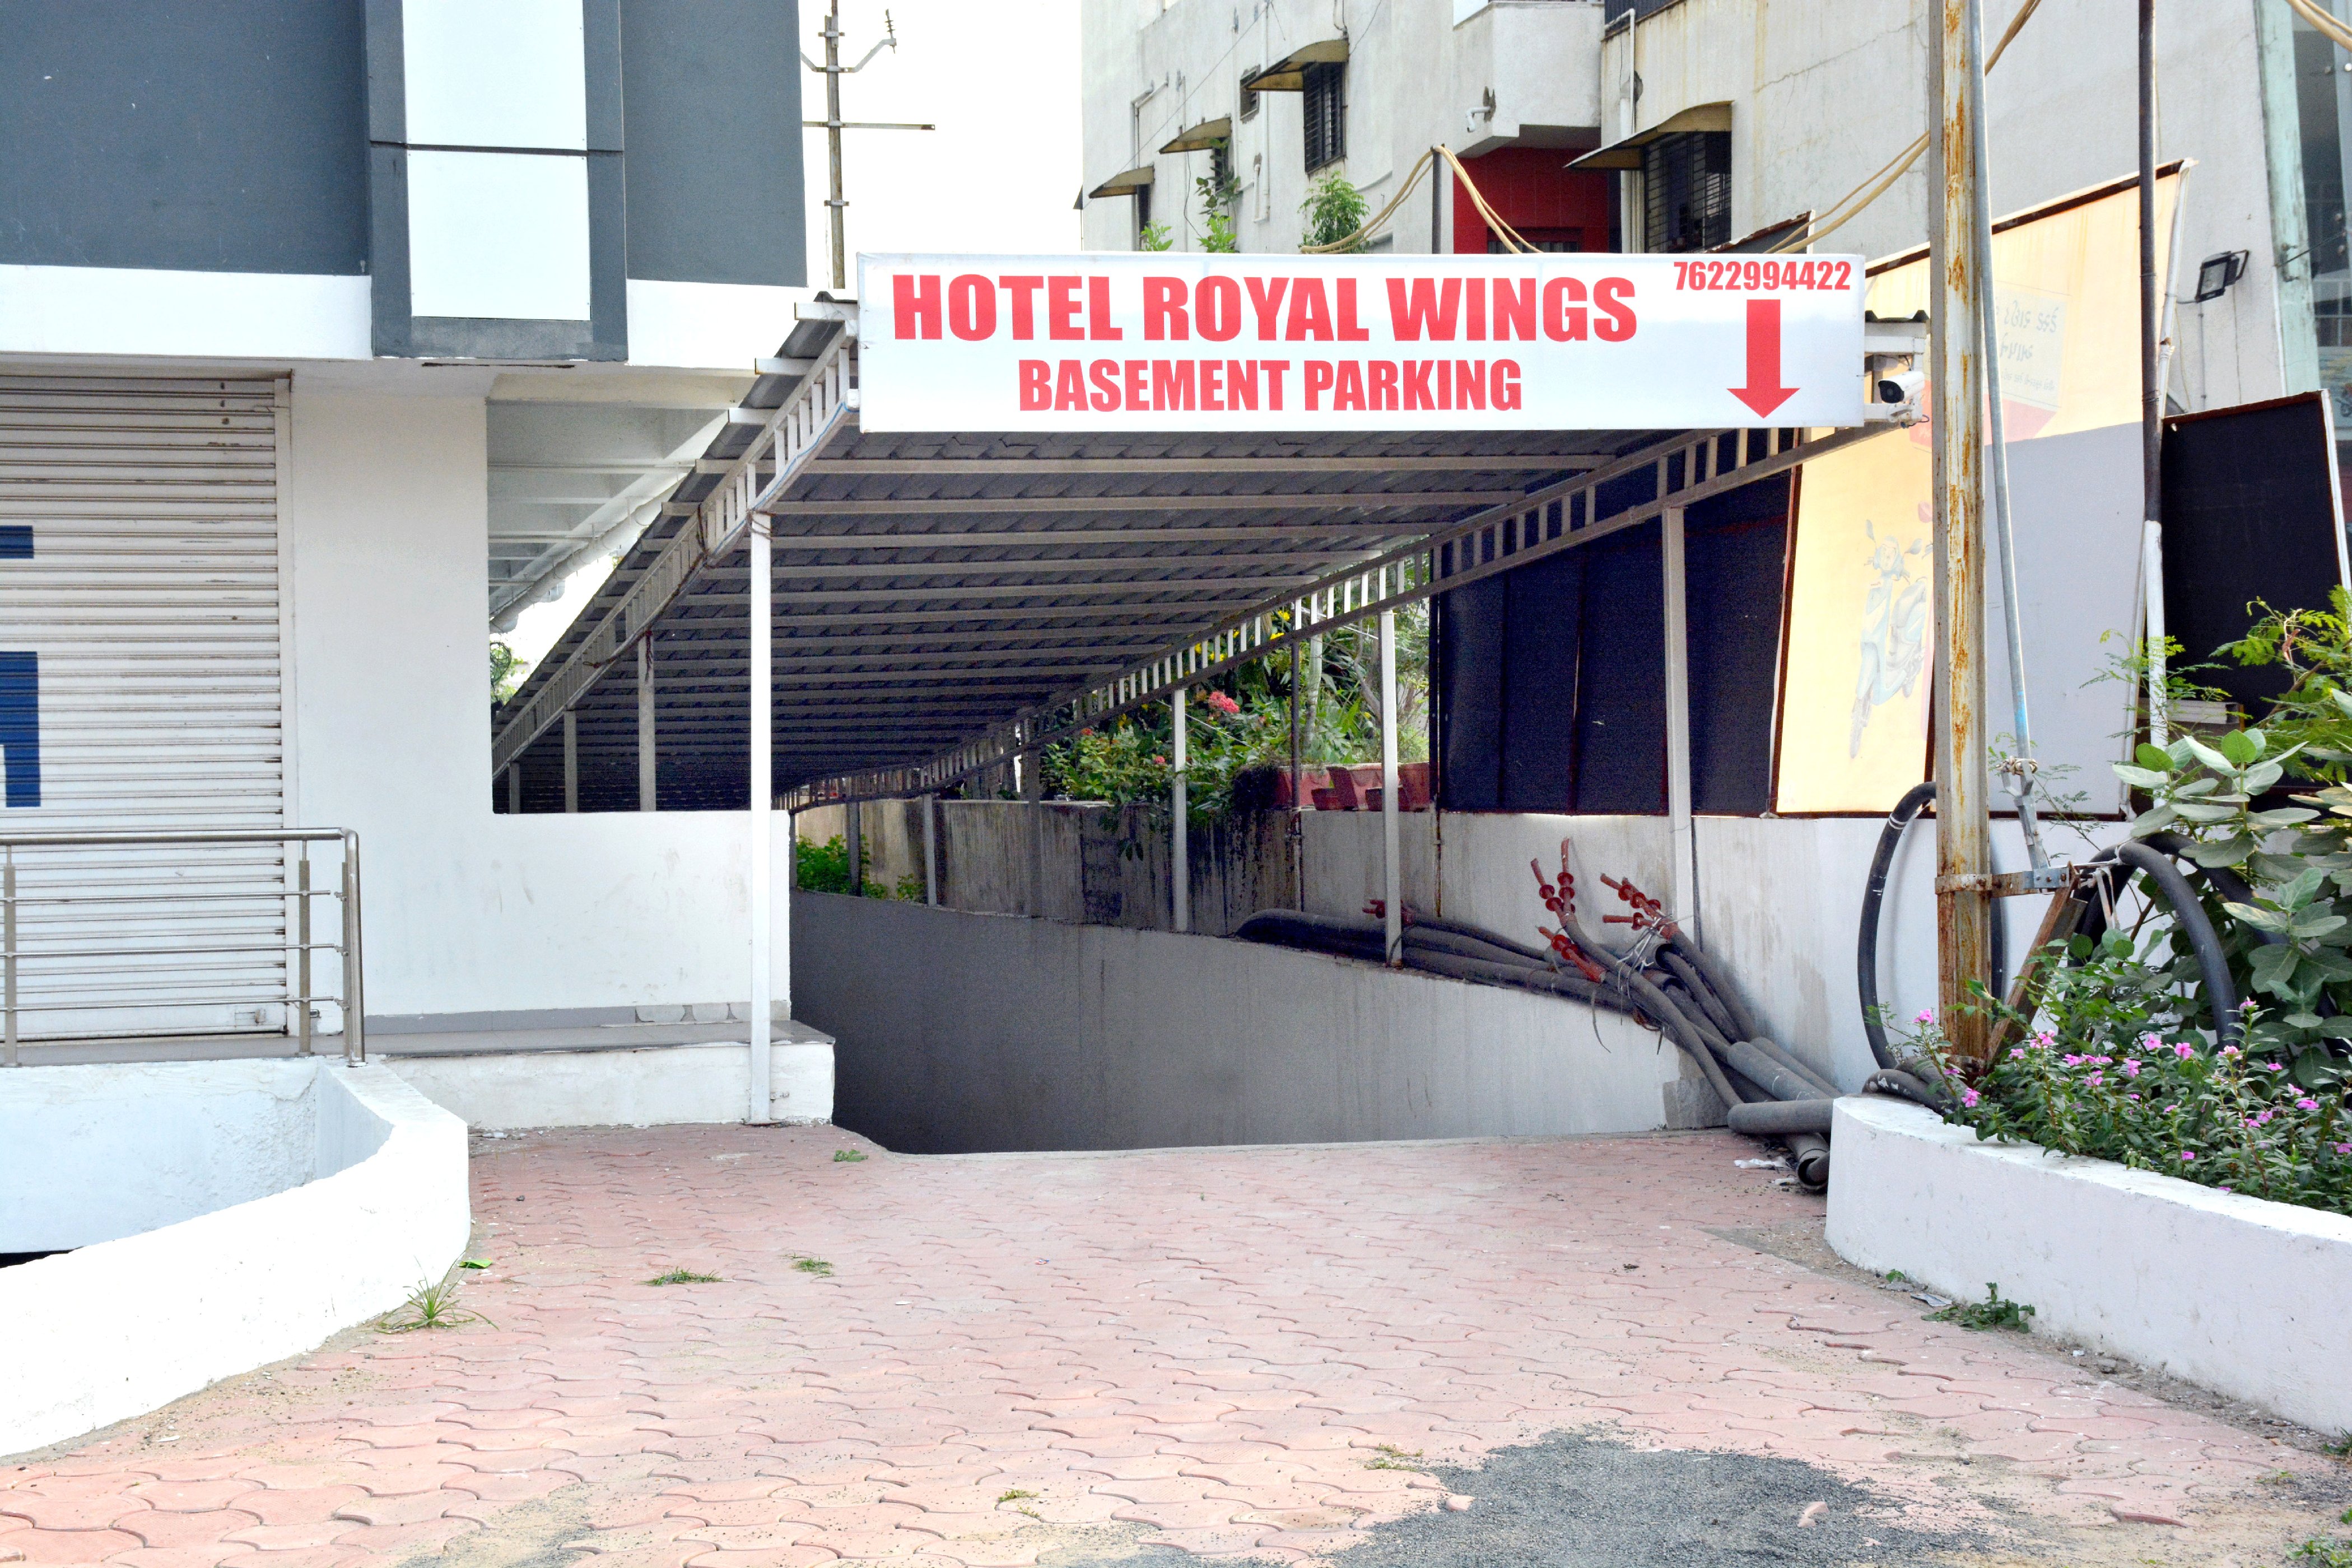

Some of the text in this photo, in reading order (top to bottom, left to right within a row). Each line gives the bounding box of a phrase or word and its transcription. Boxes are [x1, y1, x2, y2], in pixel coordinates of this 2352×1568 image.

[1674, 261, 1851, 291] 7622994422
[892, 275, 1637, 342] HOTEL ROYAL WINGS
[1019, 358, 1522, 412] BASEMENT PARKING
